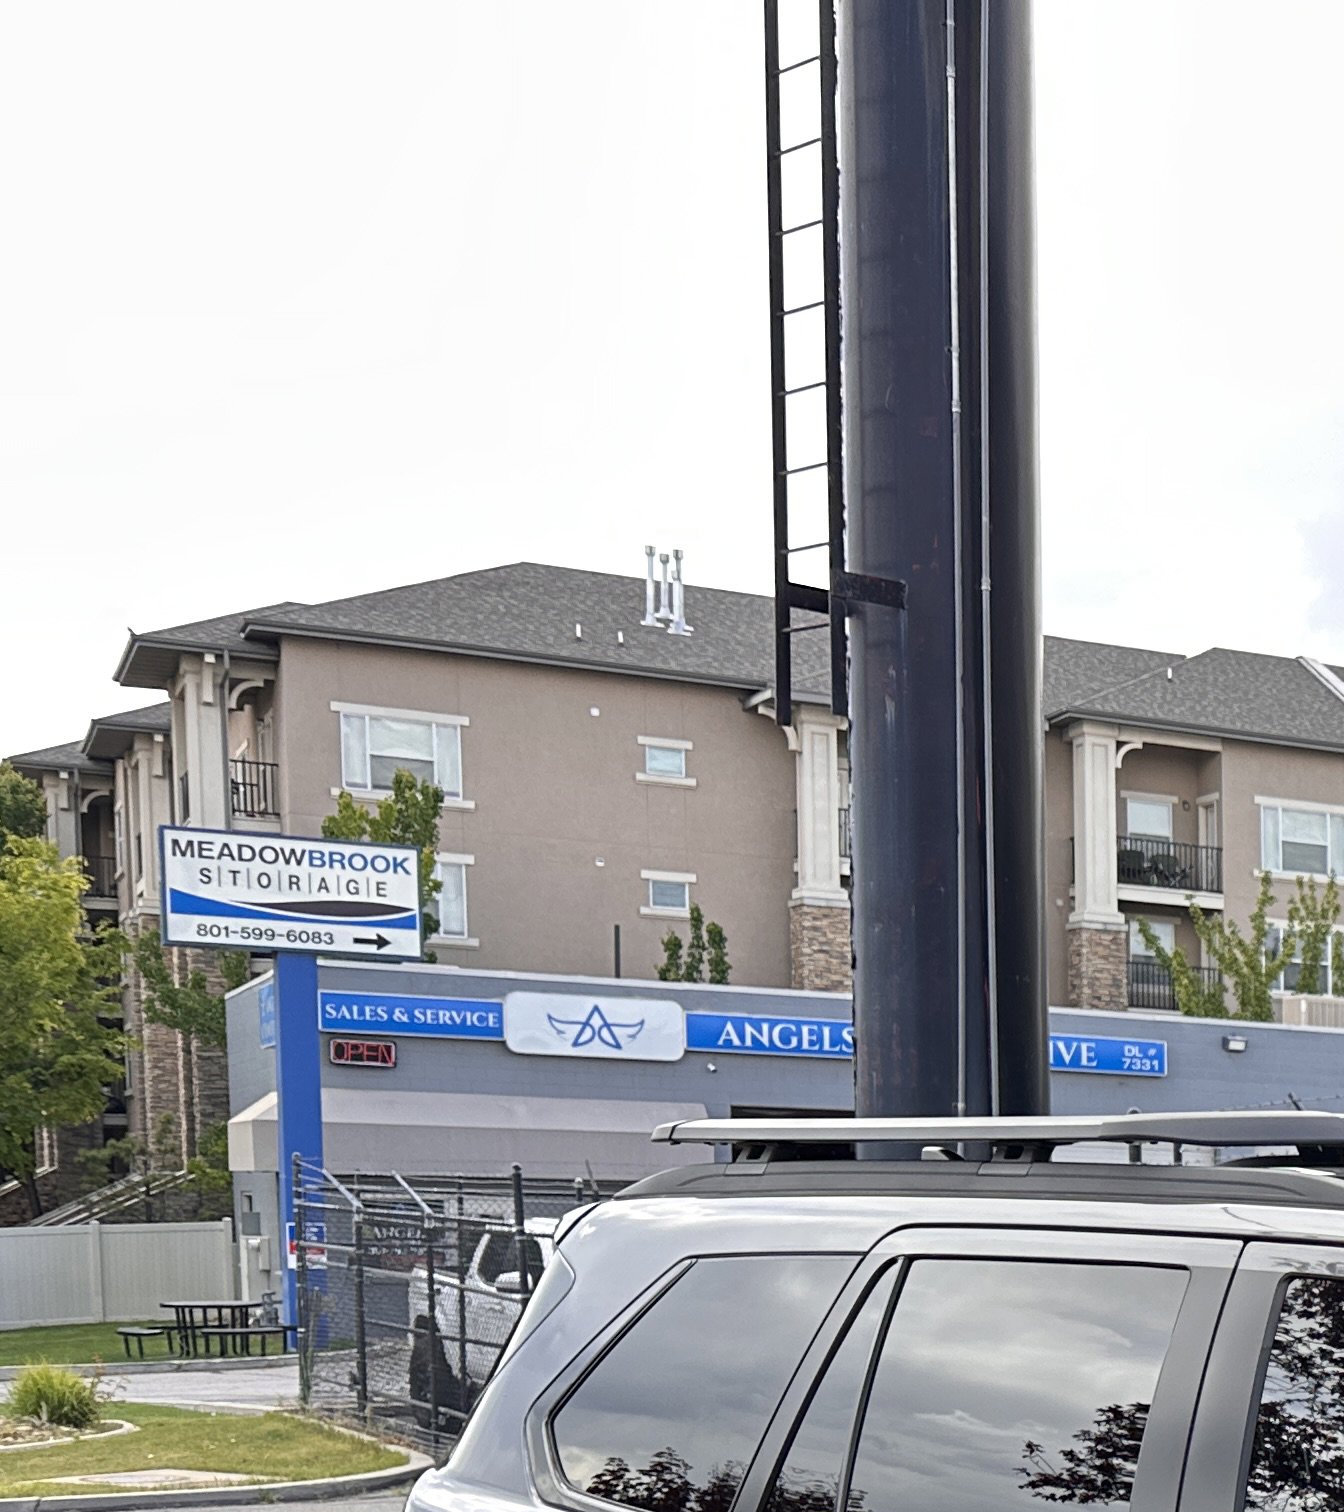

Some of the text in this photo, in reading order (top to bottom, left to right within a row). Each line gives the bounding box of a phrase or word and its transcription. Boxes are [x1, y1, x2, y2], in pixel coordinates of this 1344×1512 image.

[171, 838, 412, 875] MEADOWBROOK
[196, 923, 335, 945] 801-599-6083
[325, 1003, 500, 1028] SALES & SERVICE
[333, 1041, 395, 1065] OPEN
[1124, 1044, 1143, 1058] DL
[1122, 1057, 1159, 1071] 7331
